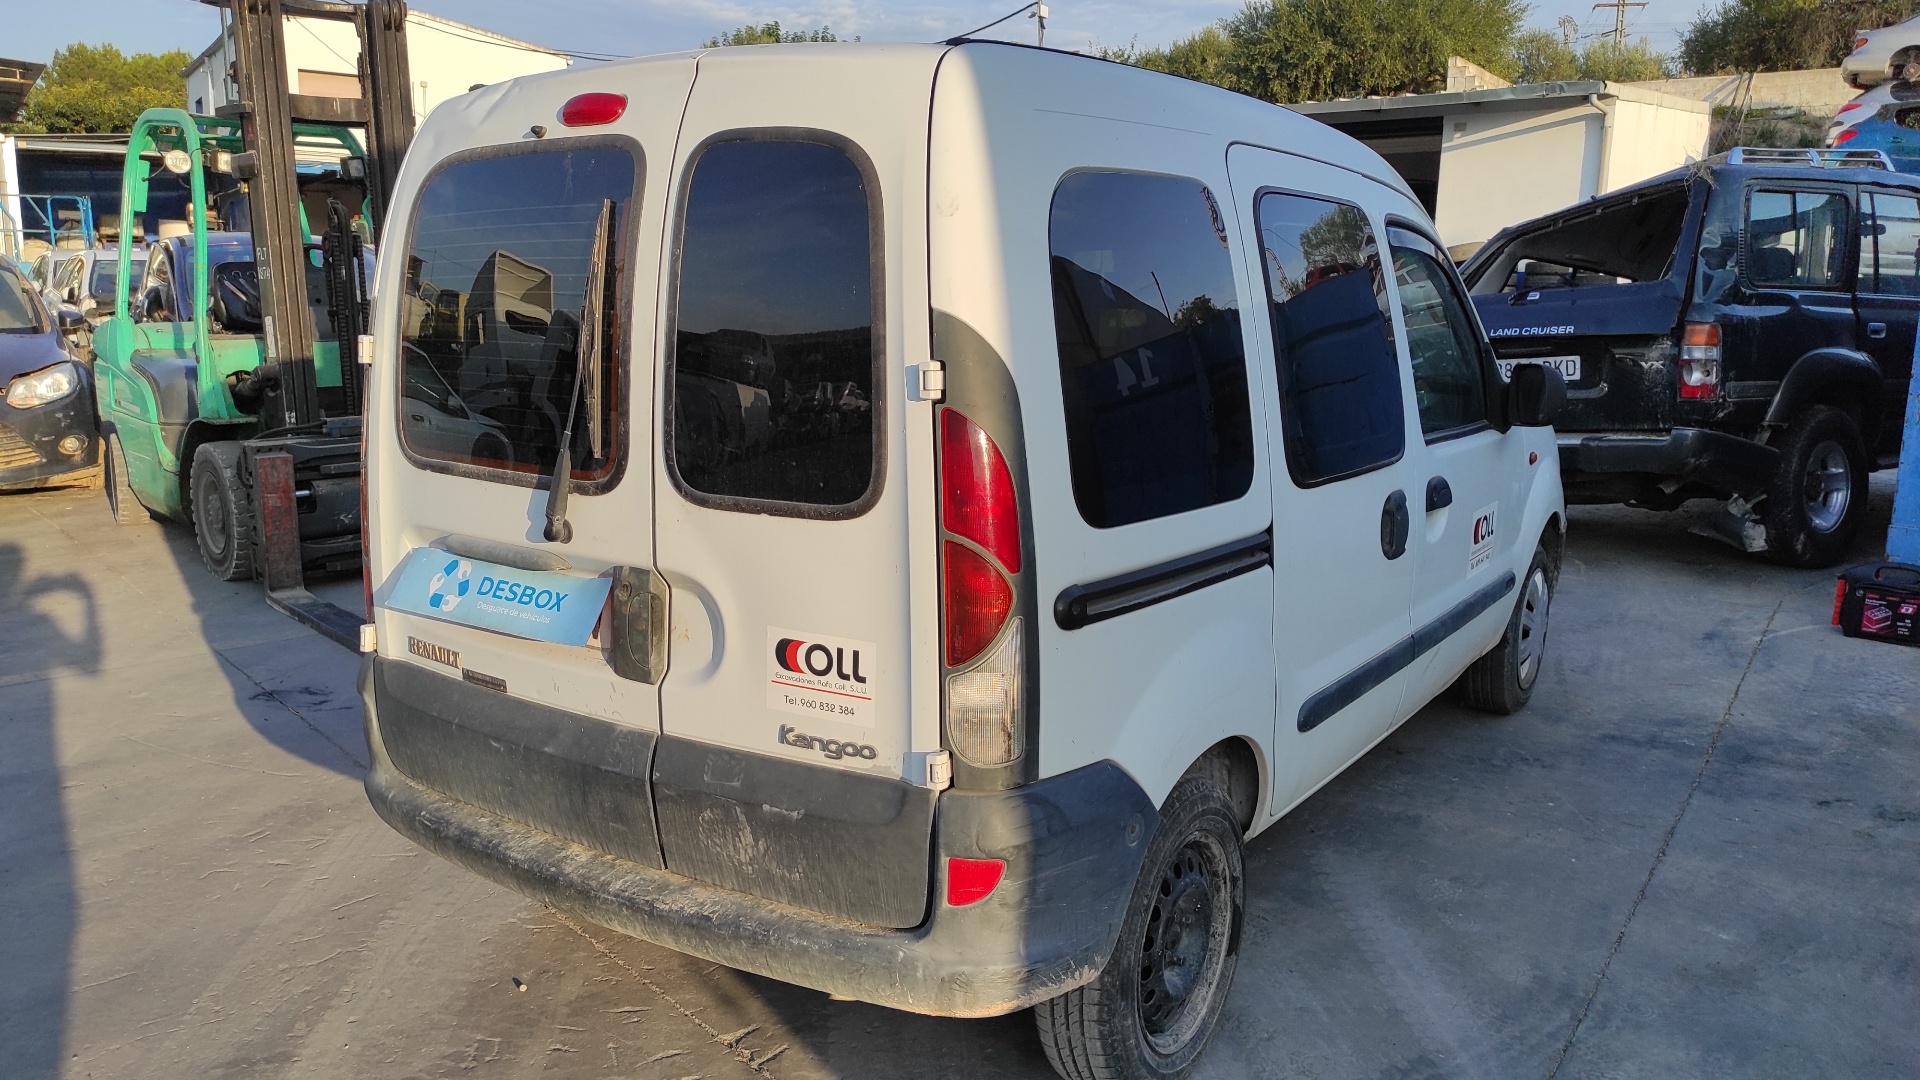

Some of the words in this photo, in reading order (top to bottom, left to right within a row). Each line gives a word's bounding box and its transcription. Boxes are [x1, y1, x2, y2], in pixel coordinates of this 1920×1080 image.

[1489, 327, 1520, 337] LAND
[1521, 325, 1575, 336] CRUISER
[476, 576, 570, 612] DESBOX
[476, 601, 509, 614] Desguace
[509, 608, 519, 617] de
[407, 635, 462, 670] RENAULT
[818, 701, 836, 713] 832
[838, 704, 855, 716] 384
[777, 723, 879, 760] Kangoo
